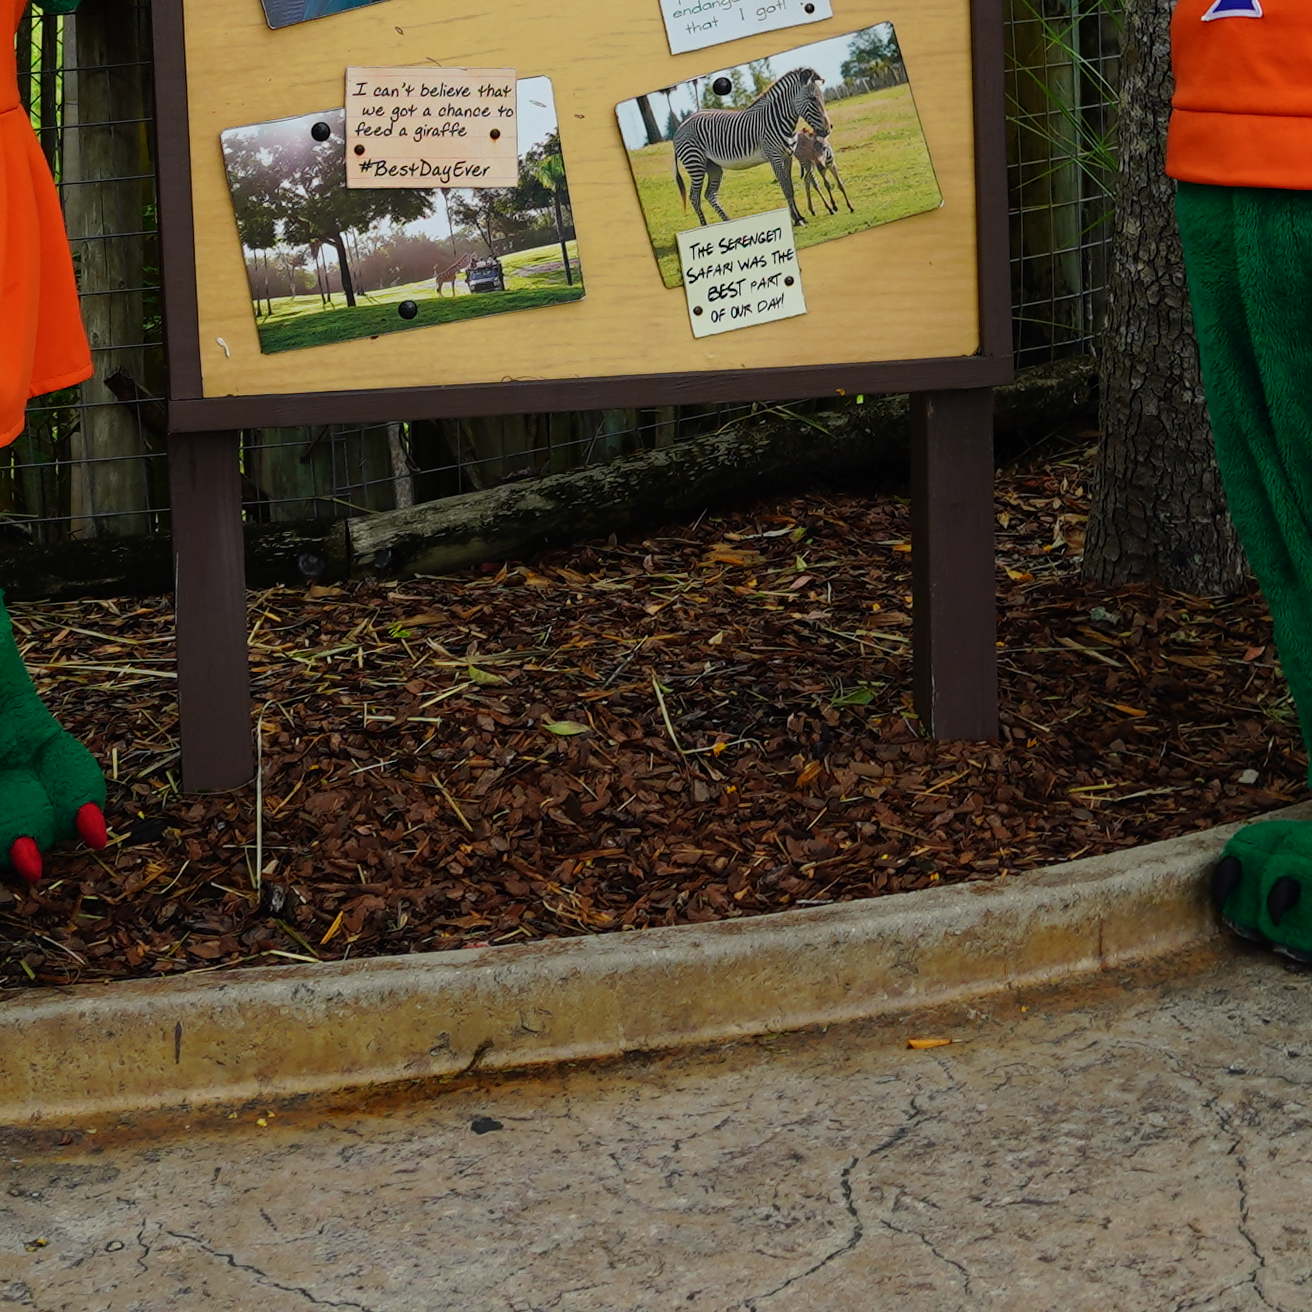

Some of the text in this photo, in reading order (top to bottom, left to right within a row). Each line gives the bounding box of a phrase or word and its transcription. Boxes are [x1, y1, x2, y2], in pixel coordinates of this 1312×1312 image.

[685, 17, 719, 34] that
[739, 8, 745, 20] I
[352, 82, 511, 97] I can't believe that
[362, 103, 514, 122] we got a chance to
[355, 122, 467, 142] feed a giraffe
[359, 159, 490, 184] #BestDayEver
[689, 227, 782, 260] THE SERENGETI
[686, 248, 795, 284] SAFARI WAS THE
[707, 273, 782, 302] BEST PART
[711, 293, 784, 323] OF OUR DAY!
